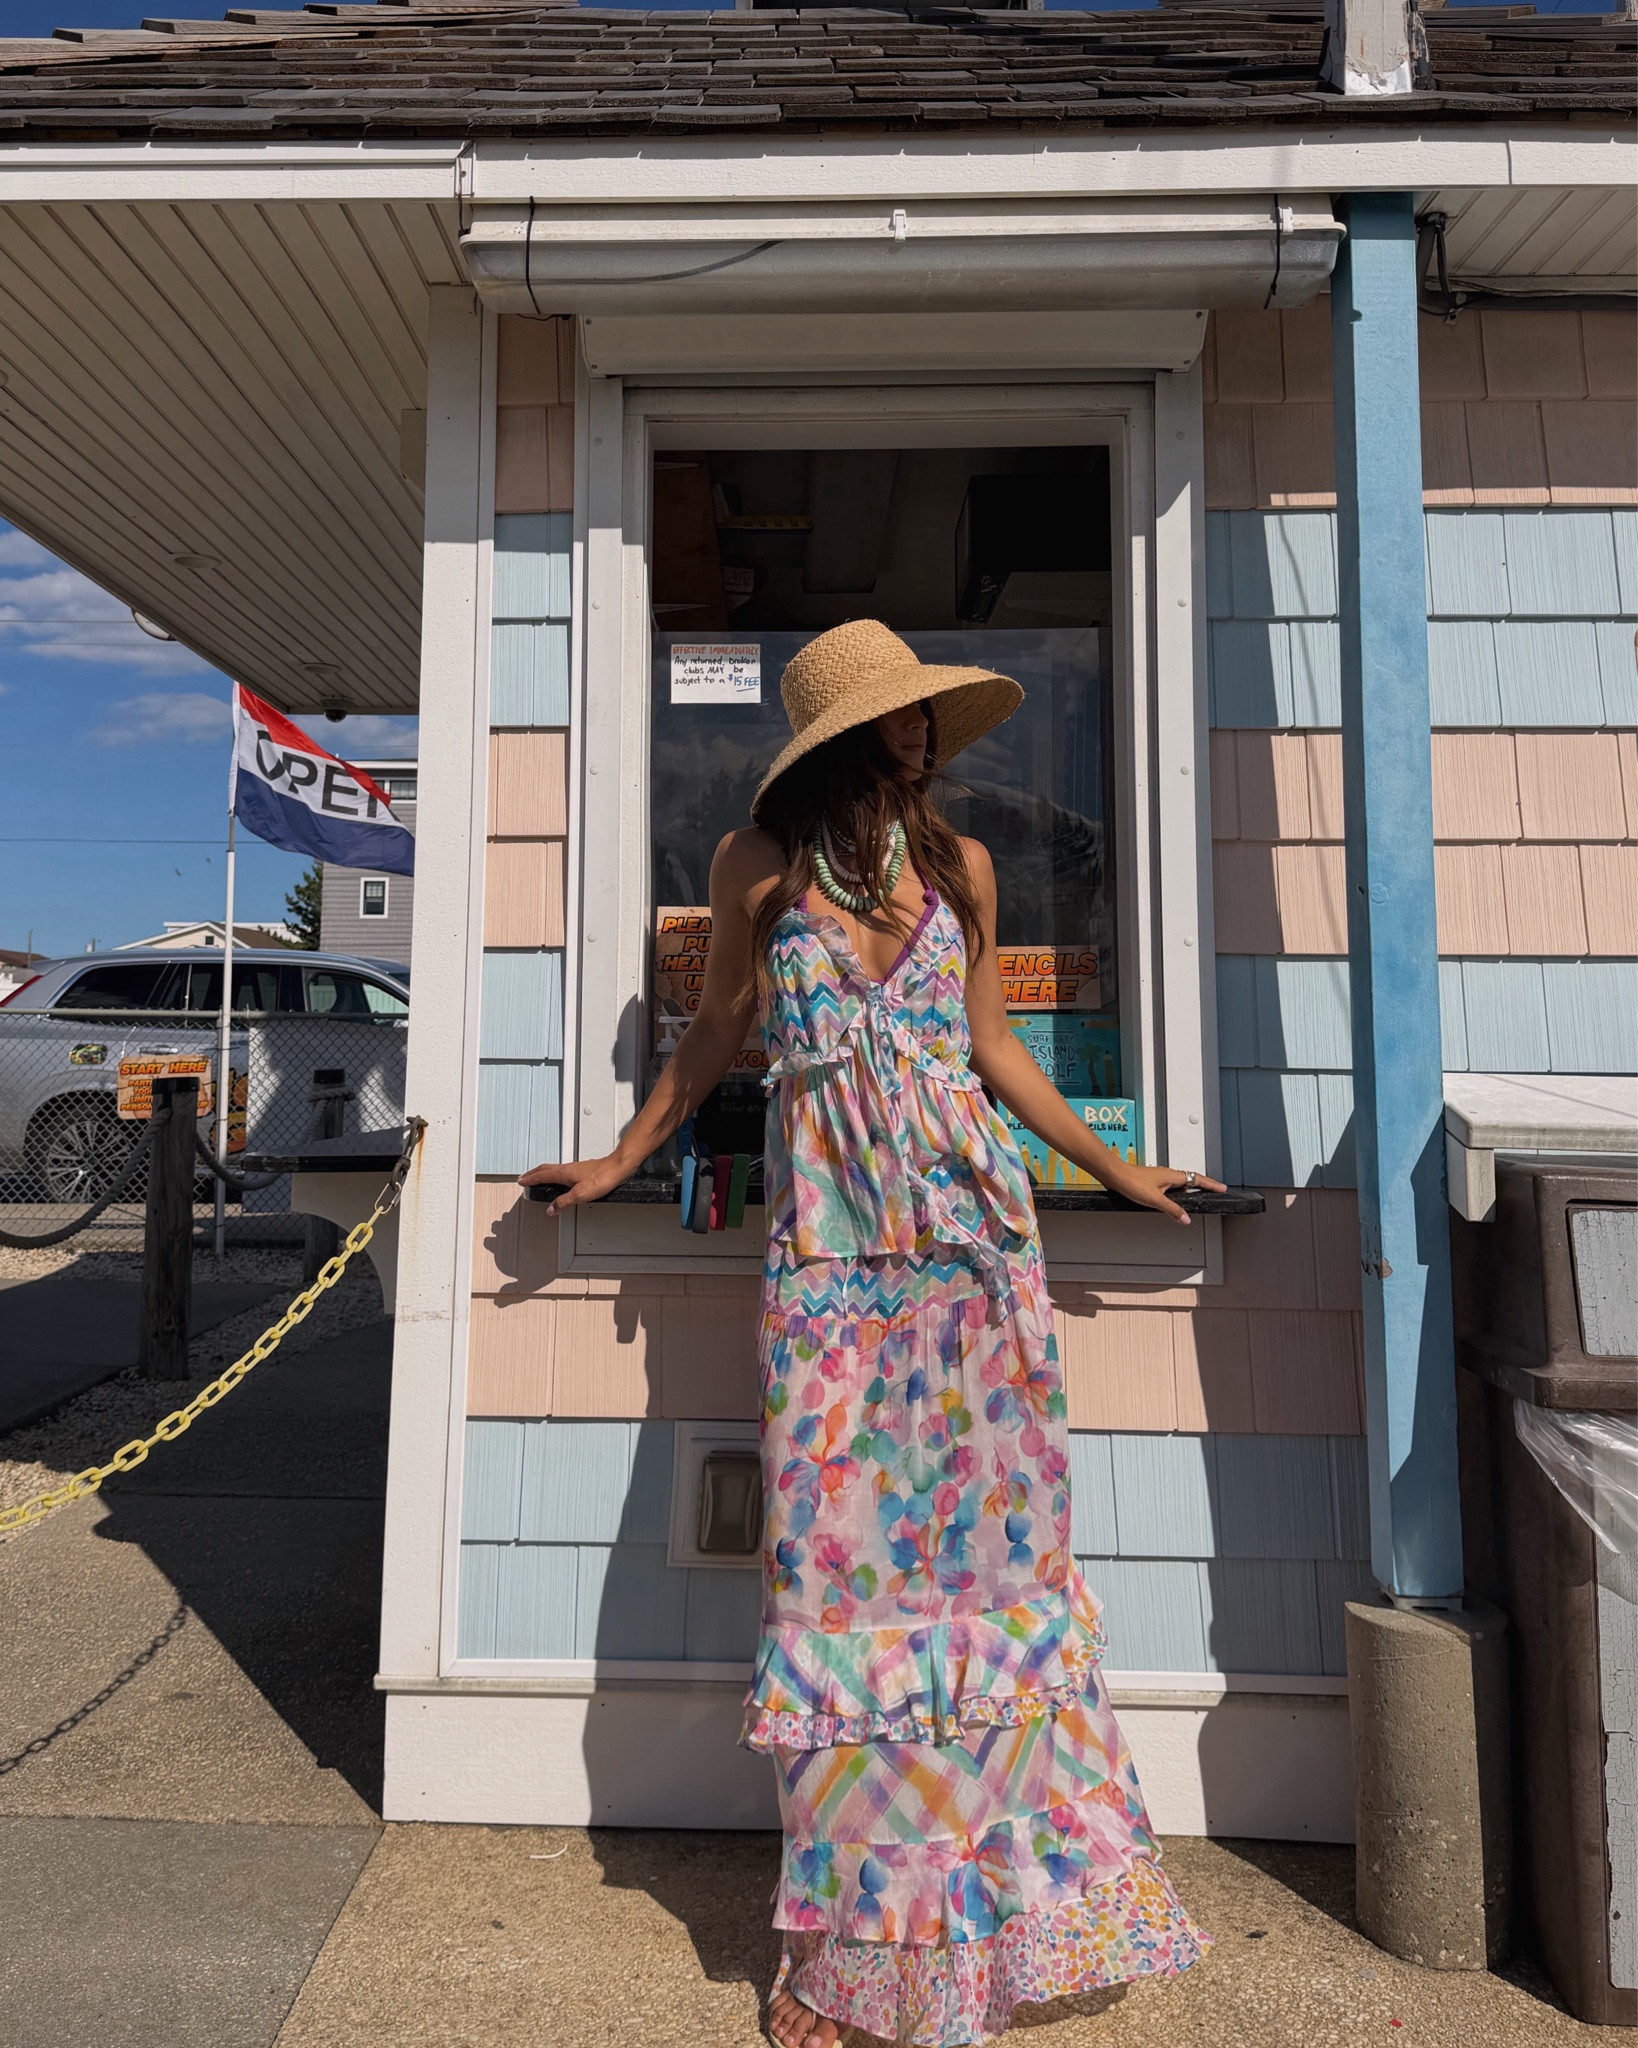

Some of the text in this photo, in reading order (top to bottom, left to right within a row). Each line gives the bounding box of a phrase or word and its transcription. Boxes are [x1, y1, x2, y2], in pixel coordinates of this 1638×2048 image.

[673, 646, 707, 655] EFFECTIVE
[674, 655, 688, 668] Any
[728, 656, 756, 665] broken
[683, 665, 744, 675] clubs MAY be
[674, 676, 701, 686] subject
[703, 676, 715, 684] to
[743, 676, 761, 687] FEE
[1002, 979, 1079, 1003] HERE
[1027, 1033, 1049, 1043] SURF
[1028, 1044, 1076, 1061] ISLAND
[120, 1060, 208, 1076] START HERE
[1038, 1061, 1077, 1078] OLF
[1084, 1104, 1127, 1125] BOX
[1107, 1123, 1129, 1132] HERE
